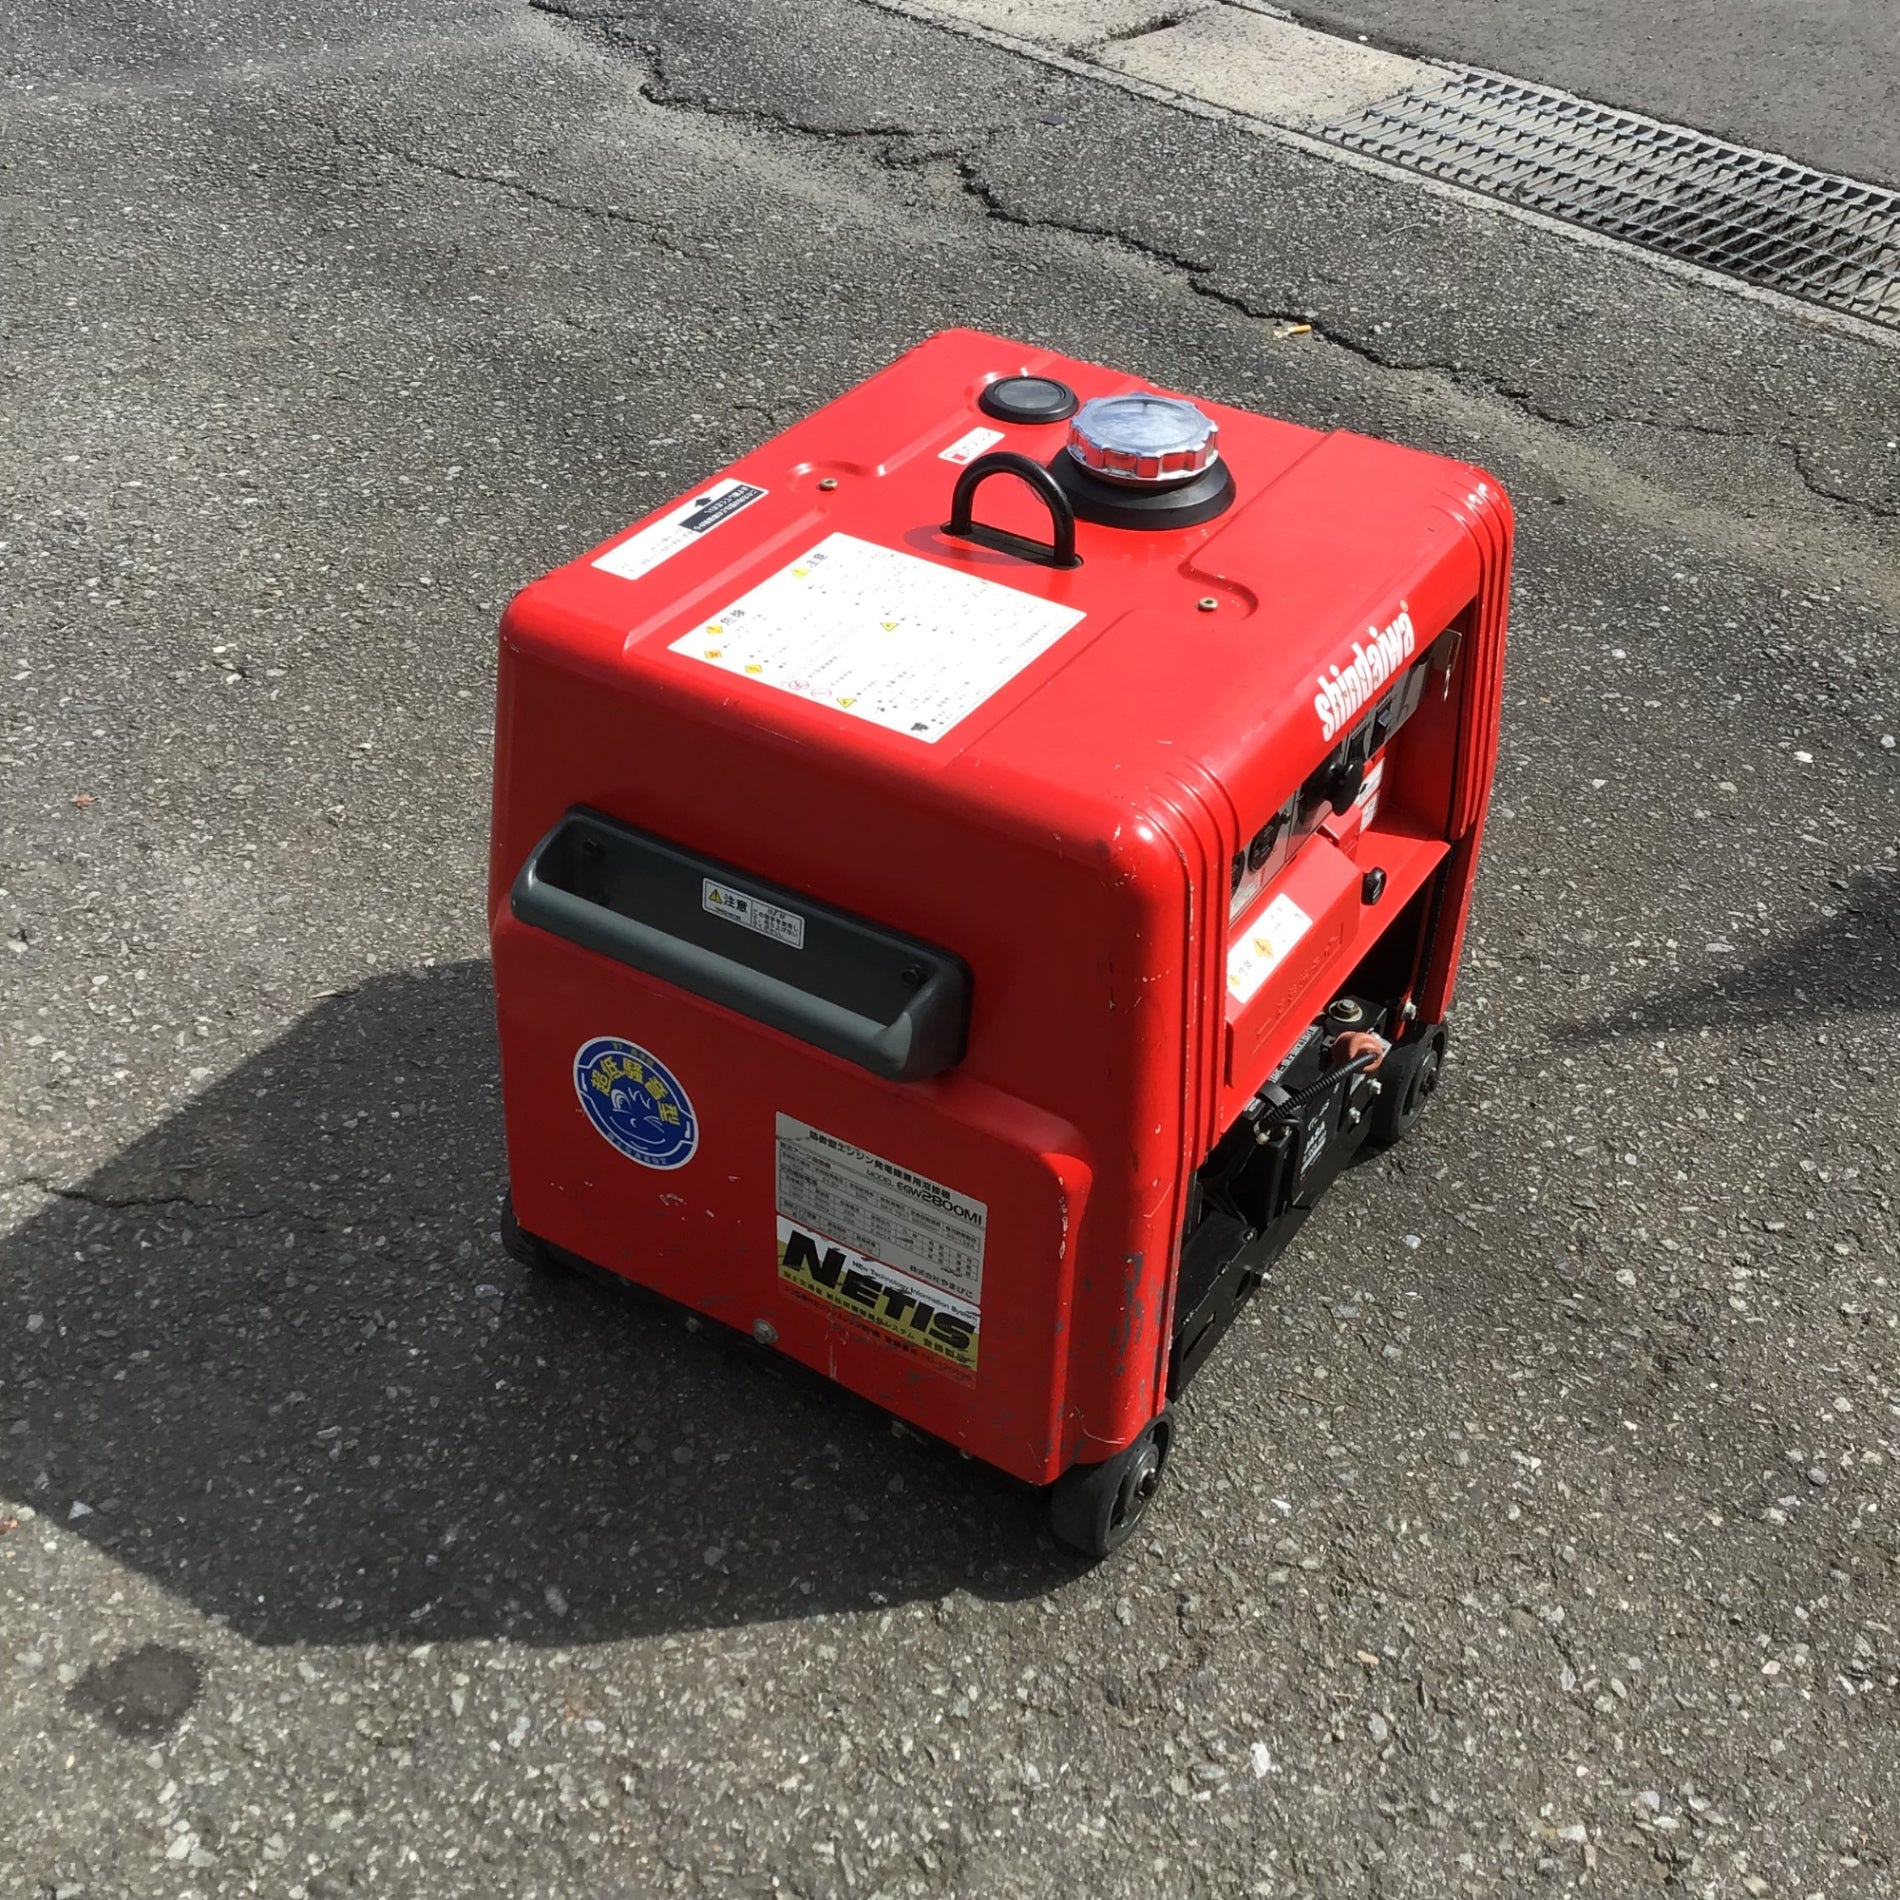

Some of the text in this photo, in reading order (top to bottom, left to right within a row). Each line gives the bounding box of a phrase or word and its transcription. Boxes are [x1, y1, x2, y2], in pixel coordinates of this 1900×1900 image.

[1314, 611, 1415, 742] shindaiwa
[723, 893, 748, 914] 注意
[591, 1056, 680, 1126] 超低騒音型
[866, 1168, 894, 1187] MODEL
[896, 1181, 983, 1226] EGW2800MI
[783, 1229, 976, 1351] NETIS
[869, 1267, 909, 1292] Technology
[910, 1284, 950, 1309] Information
[951, 1303, 979, 1322] System
